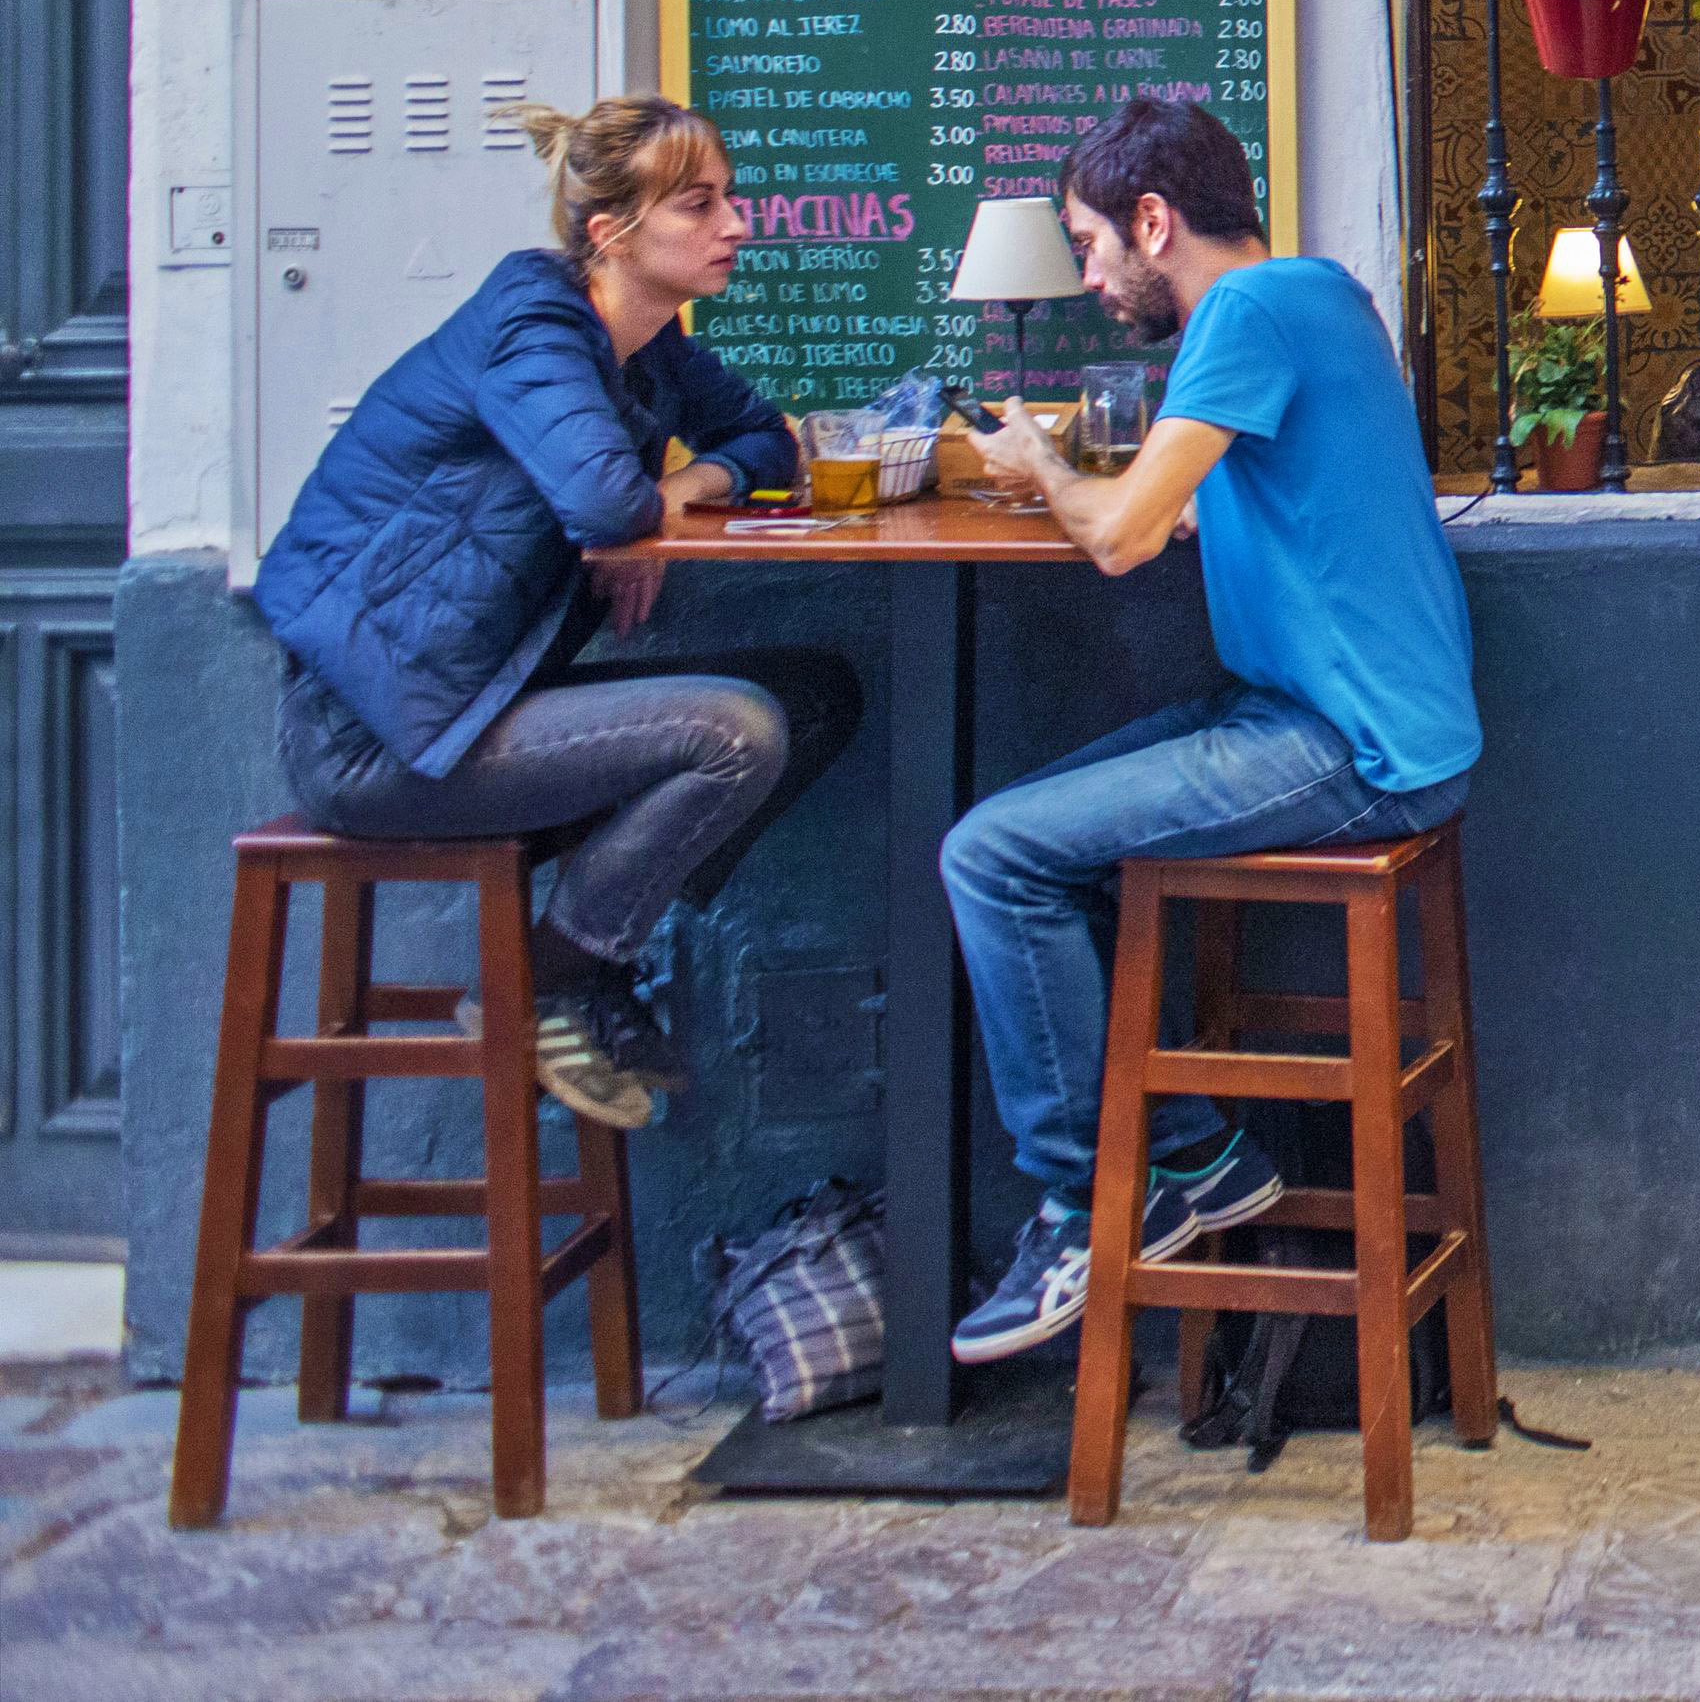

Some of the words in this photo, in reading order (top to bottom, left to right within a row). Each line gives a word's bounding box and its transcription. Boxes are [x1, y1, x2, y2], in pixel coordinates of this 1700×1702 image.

[705, 16, 759, 38] LOMO
[766, 18, 794, 37] AL
[797, 14, 864, 36] JEREZ
[1218, 19, 1263, 38] 2.80
[705, 55, 821, 76] SALMOREJO
[1071, 51, 1096, 69] DE
[1216, 49, 1261, 69] 2.80
[708, 87, 780, 111] PASTEL
[784, 90, 812, 109] DE
[819, 90, 911, 109] CABRACHO
[929, 87, 975, 108] 3.50
[1094, 85, 1106, 103] A
[1110, 85, 1132, 102] LA
[1219, 80, 1266, 101] 2.80
[767, 129, 868, 148] CANUTERA
[929, 126, 975, 146] 3.00
[774, 164, 798, 181] EN
[804, 162, 898, 182] ESCABECHE
[730, 192, 915, 238] HACINAS
[779, 283, 805, 302] DE
